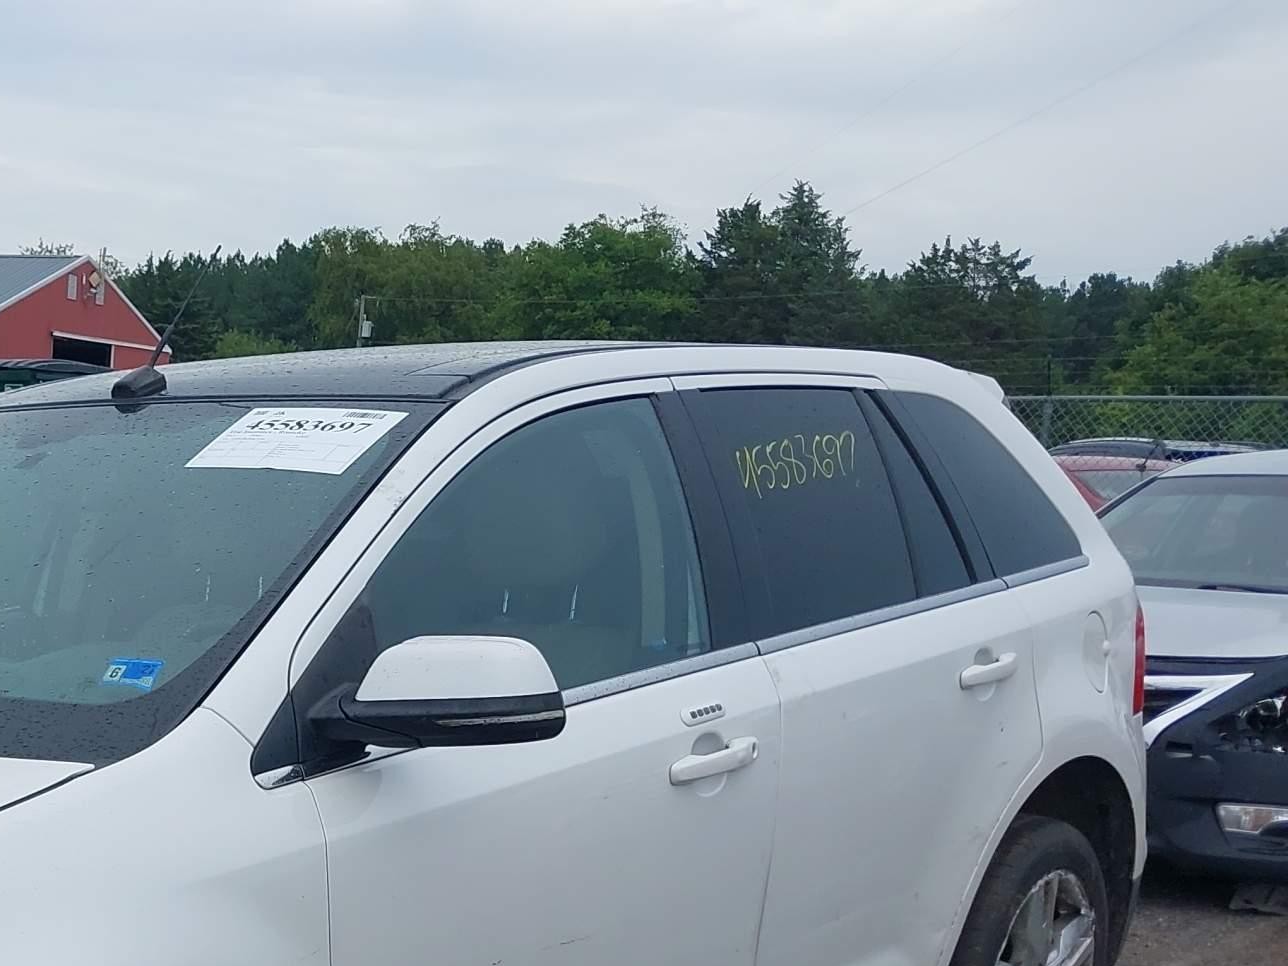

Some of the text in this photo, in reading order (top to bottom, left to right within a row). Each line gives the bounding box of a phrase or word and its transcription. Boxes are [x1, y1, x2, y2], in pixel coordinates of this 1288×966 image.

[246, 419, 373, 434] 45583697
[735, 430, 855, 499] 45583697
[109, 667, 121, 678] 6
